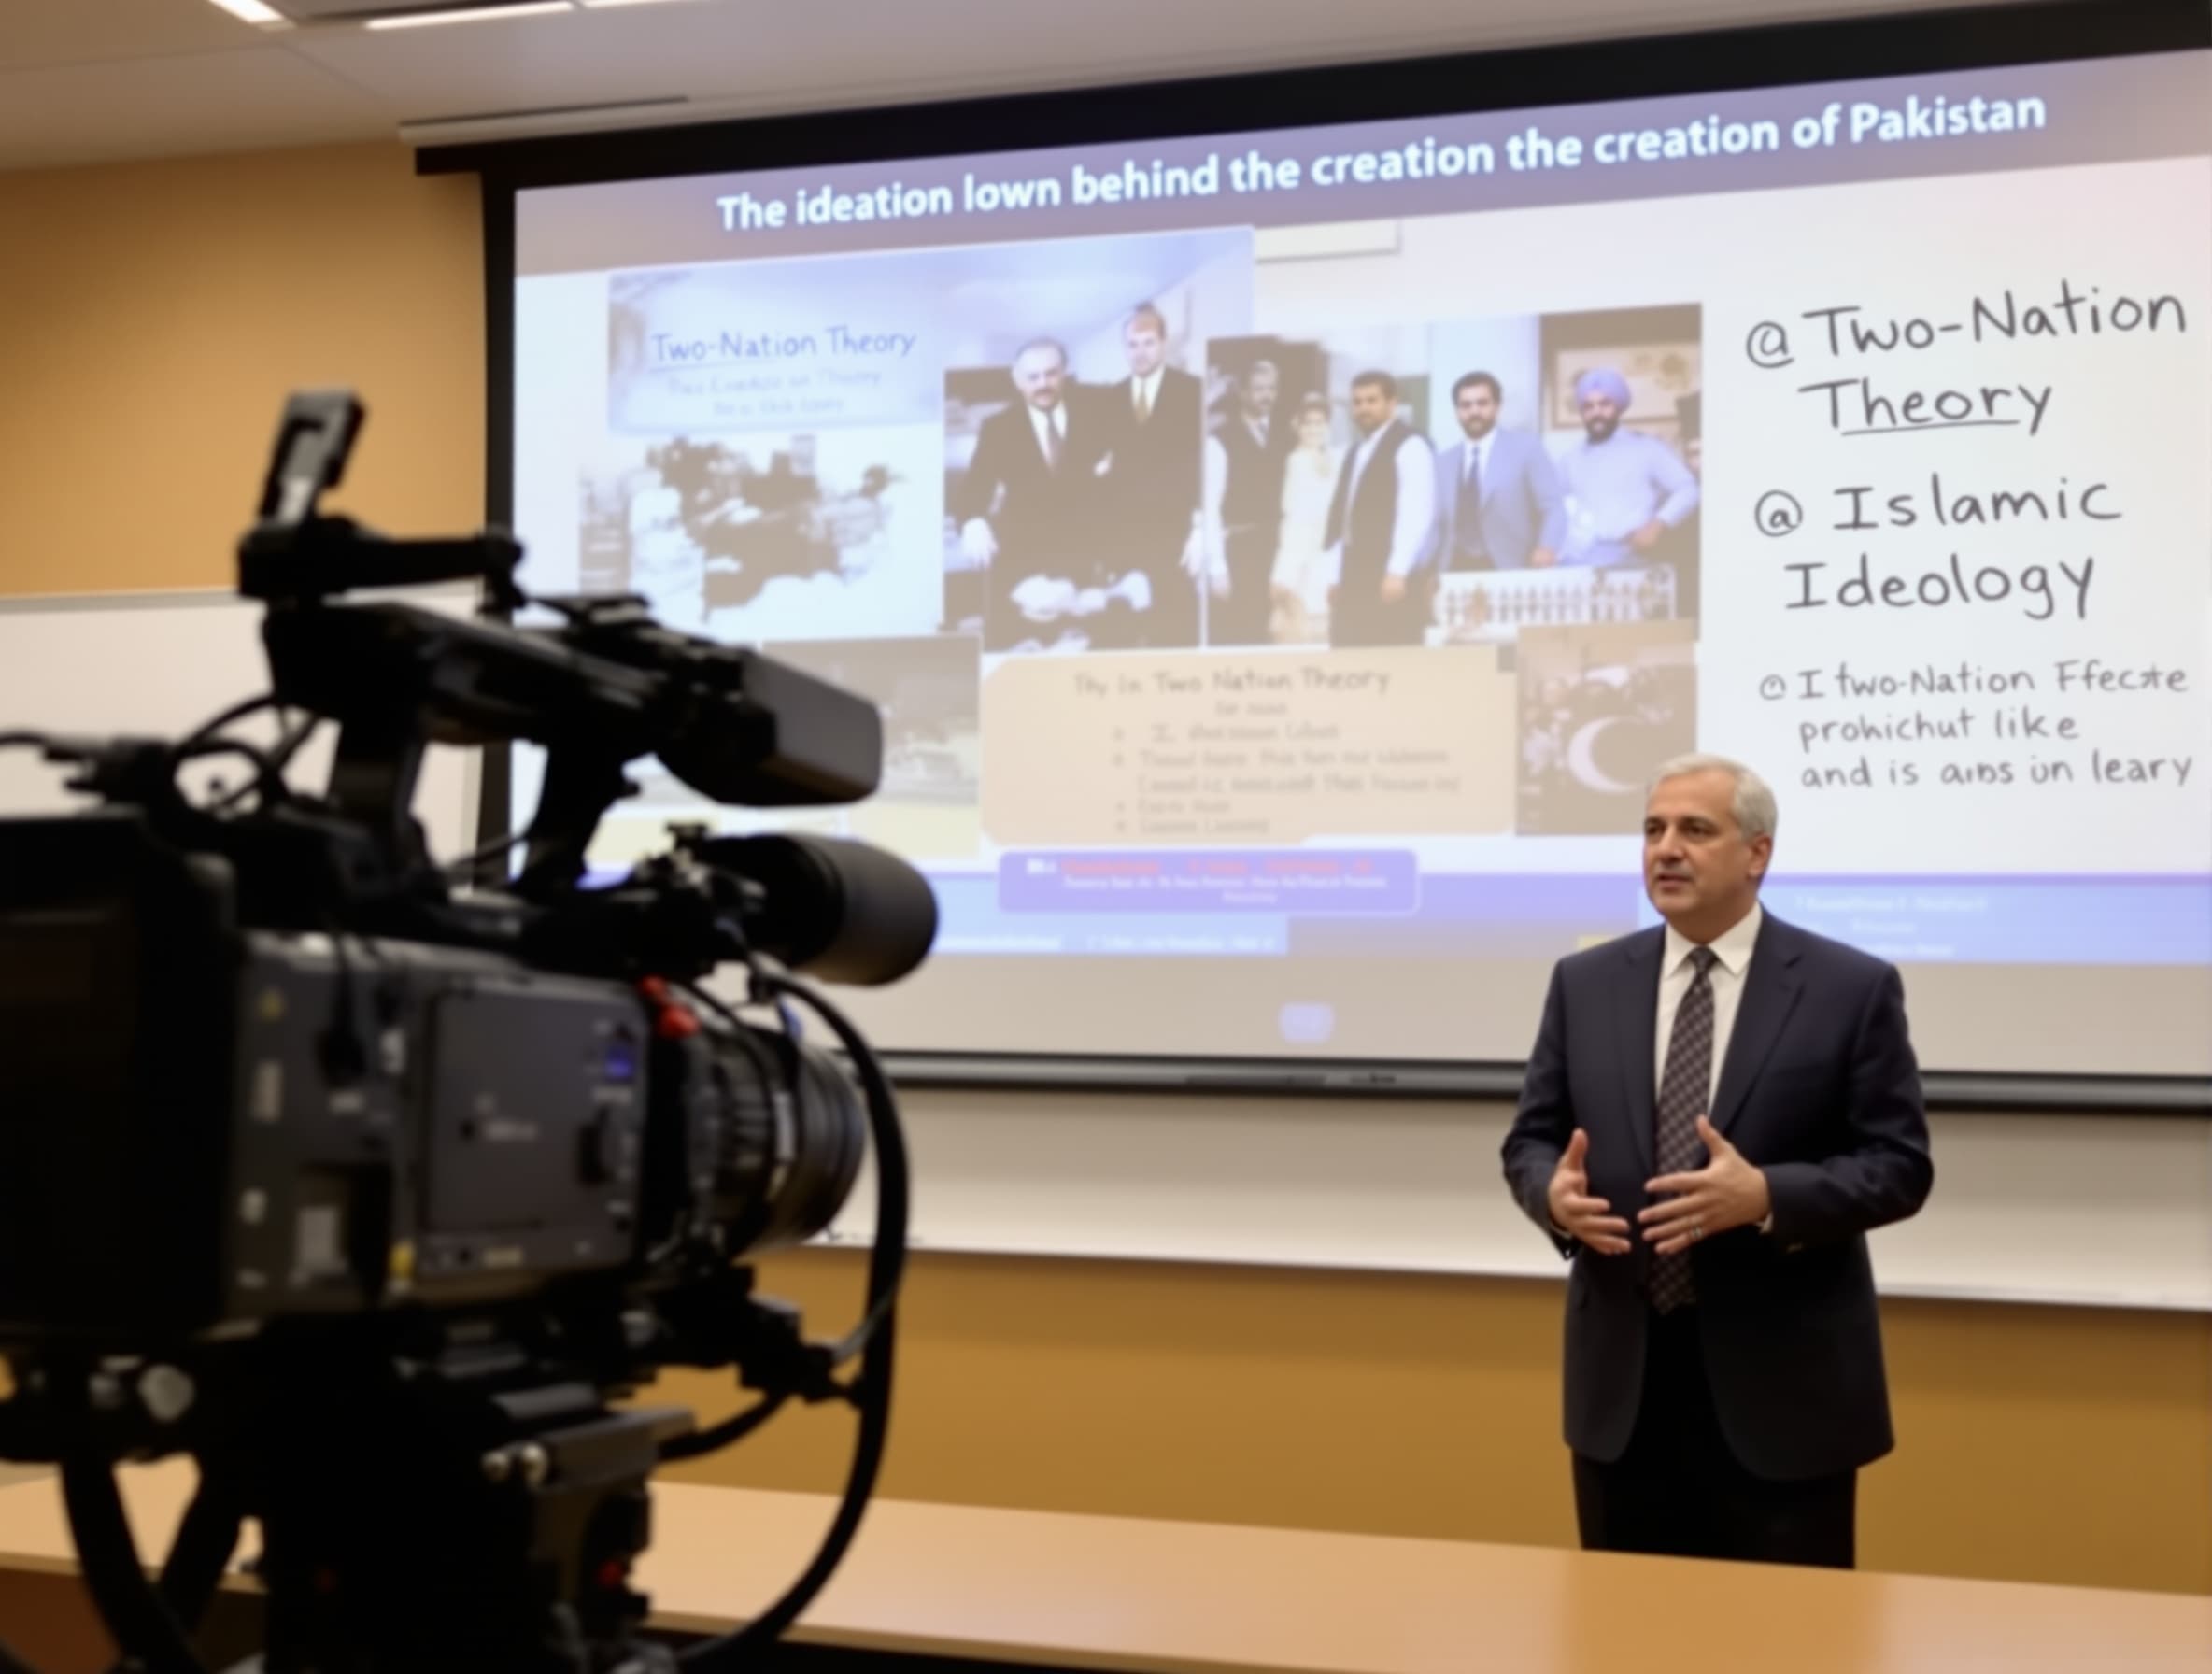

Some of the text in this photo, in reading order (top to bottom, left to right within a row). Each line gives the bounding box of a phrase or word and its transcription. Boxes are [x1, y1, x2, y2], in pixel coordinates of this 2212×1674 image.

[716, 94, 2046, 231] The ideation lown behind the creation the creation of Pakistan
[652, 324, 916, 362] Two-Nation Theory
[1801, 278, 2187, 357] Two-Nation
[1797, 376, 2052, 437] Theory
[1833, 472, 2122, 531] Islamic
[1784, 552, 2094, 621] Ideology
[1301, 665, 1389, 697] Theory
[1994, 705, 2078, 740] like
[1801, 756, 1872, 788] and
[1889, 759, 1920, 786] is
